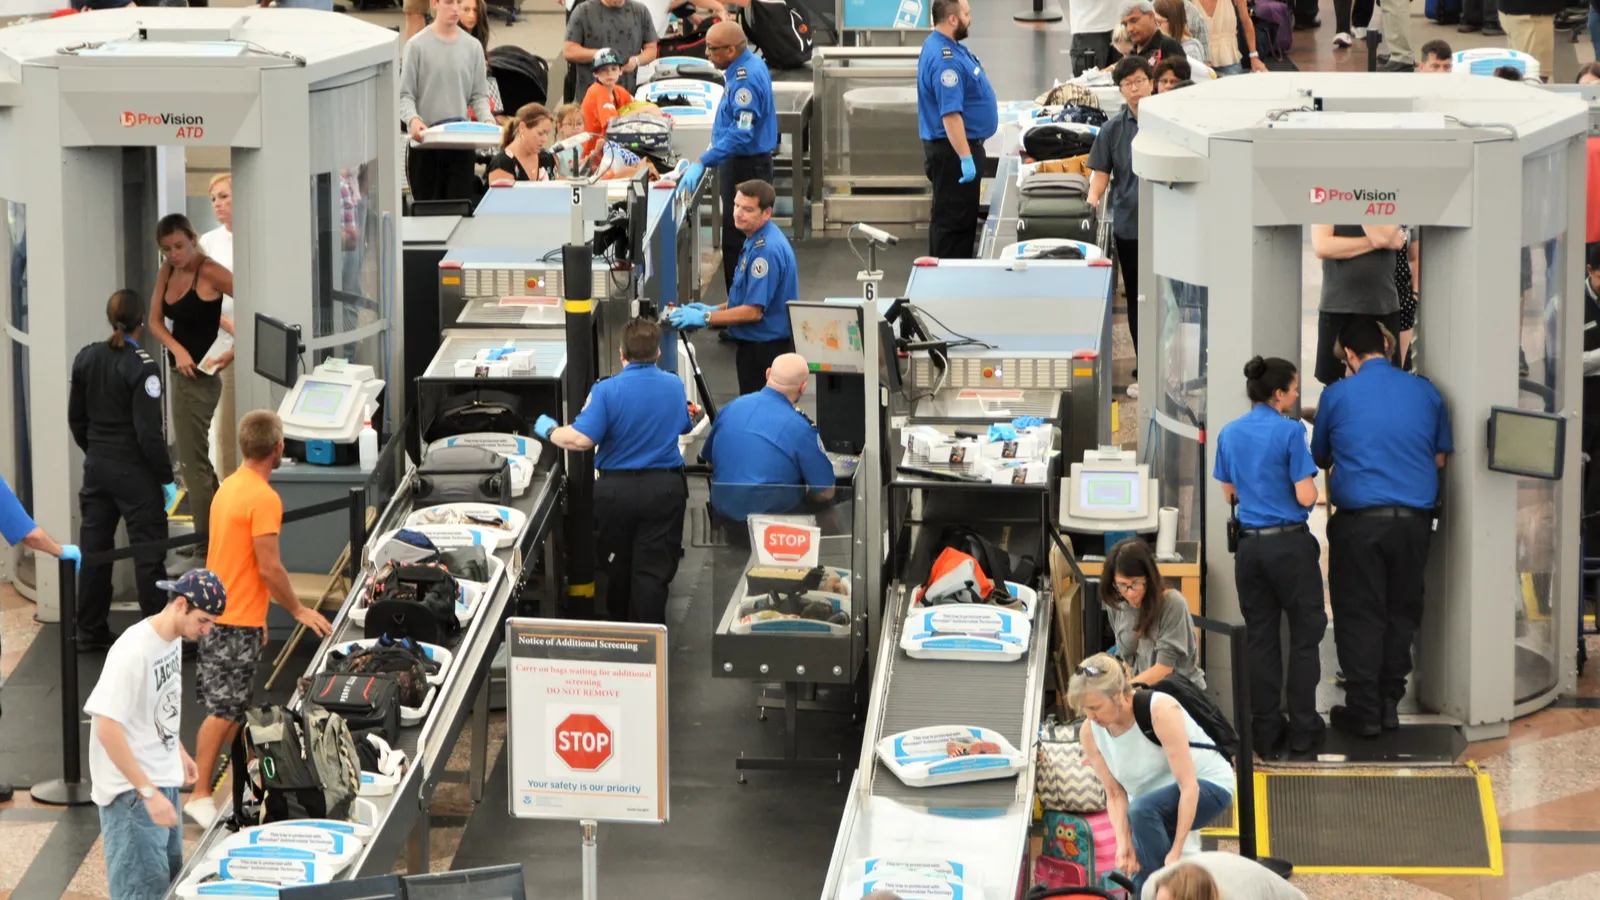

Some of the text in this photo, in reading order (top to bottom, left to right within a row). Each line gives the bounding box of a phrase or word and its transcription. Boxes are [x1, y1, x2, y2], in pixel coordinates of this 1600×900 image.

[138, 113, 203, 124] ProVision
[176, 126, 204, 138] ATD
[573, 187, 580, 204] 5
[1364, 203, 1396, 215] ATD
[866, 282, 873, 300] 6
[769, 533, 806, 547] STOP
[518, 636, 638, 652] Notice of Additional Screening
[515, 664, 536, 673] Carry
[550, 666, 567, 675] bags
[570, 668, 597, 676] waiting
[612, 669, 652, 677] additional
[566, 679, 602, 688] screening
[558, 730, 609, 752] STOP
[528, 780, 548, 788] Your
[550, 781, 578, 791] safety
[607, 784, 641, 794] priority
